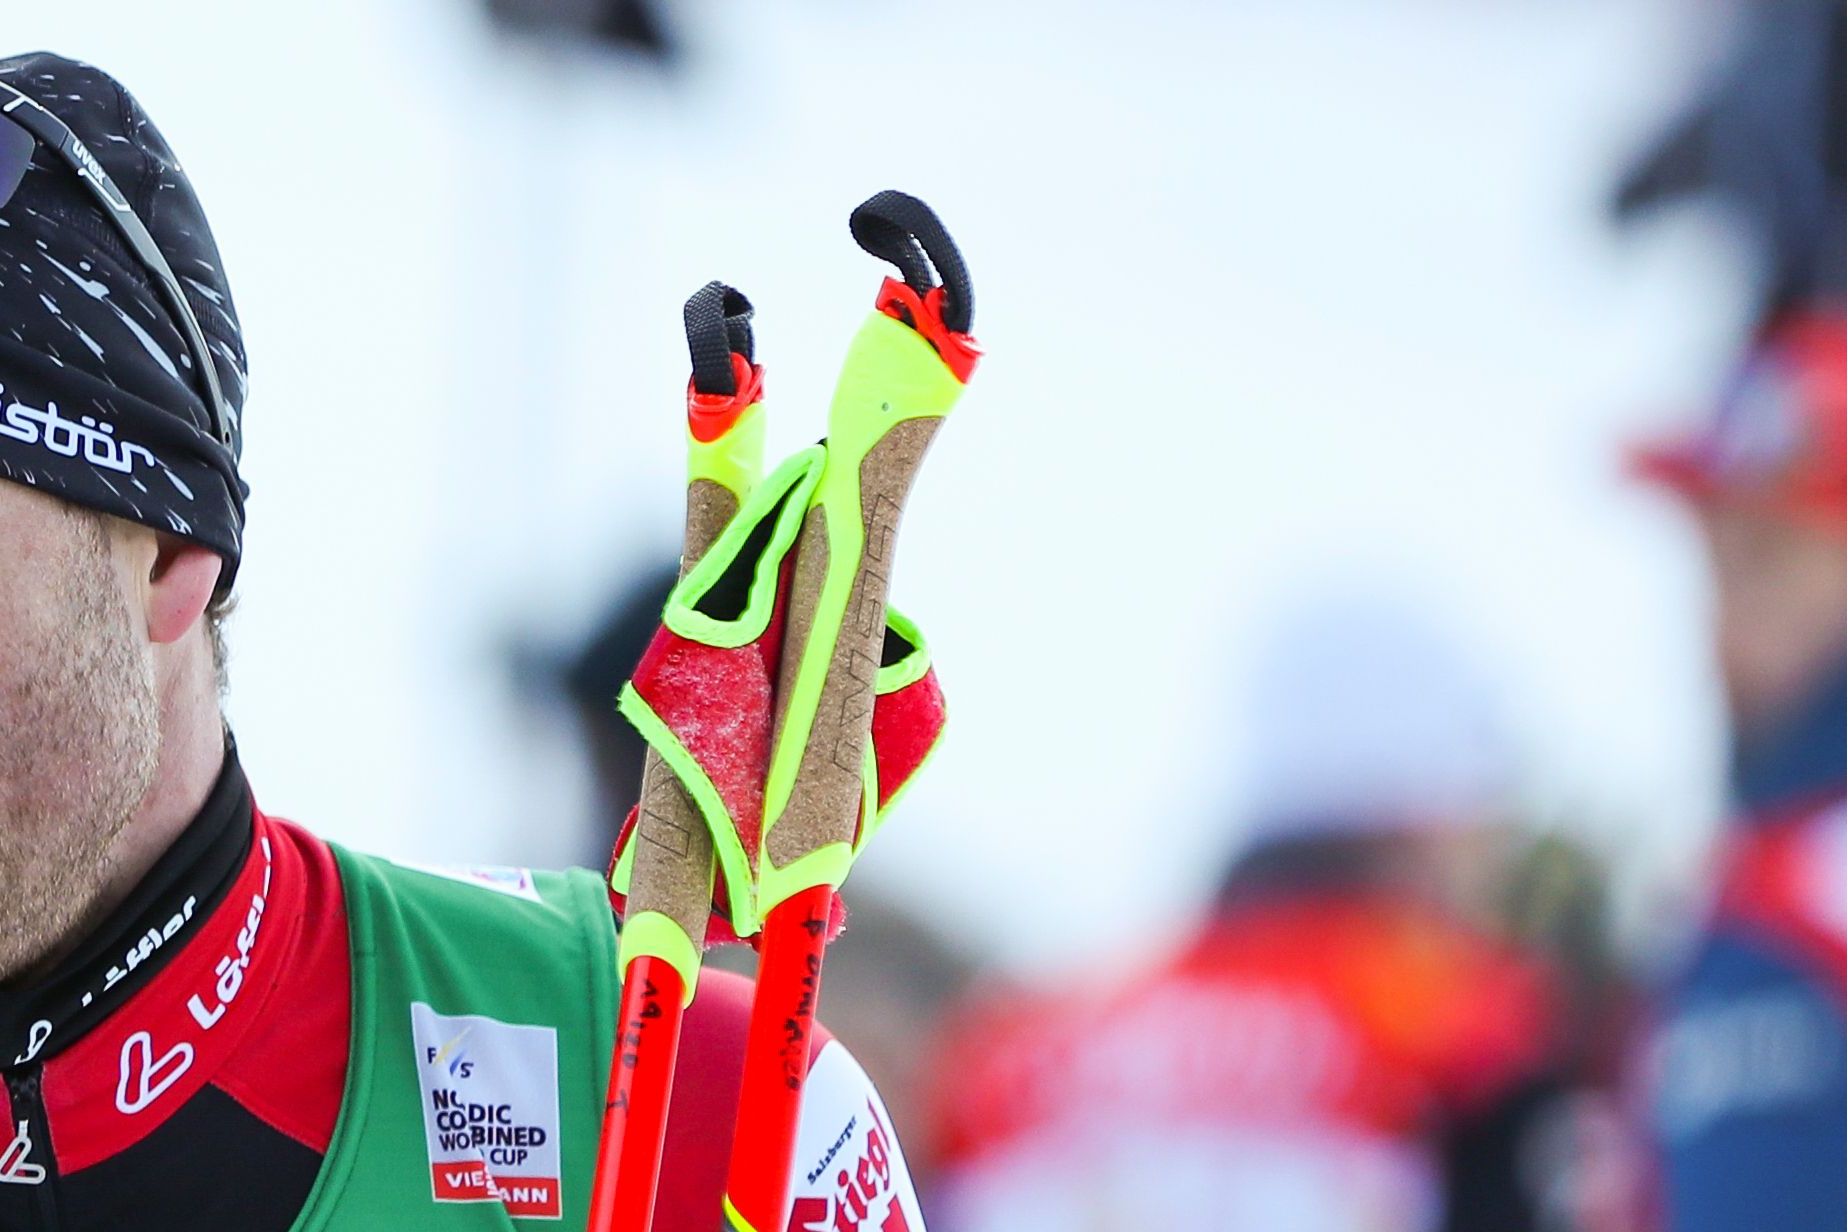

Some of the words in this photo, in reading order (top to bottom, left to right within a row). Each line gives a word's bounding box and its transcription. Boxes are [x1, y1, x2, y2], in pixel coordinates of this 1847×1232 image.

[72, 139, 106, 185] uvex
[436, 1110, 548, 1148] COBINED
[489, 1147, 529, 1167] CUP
